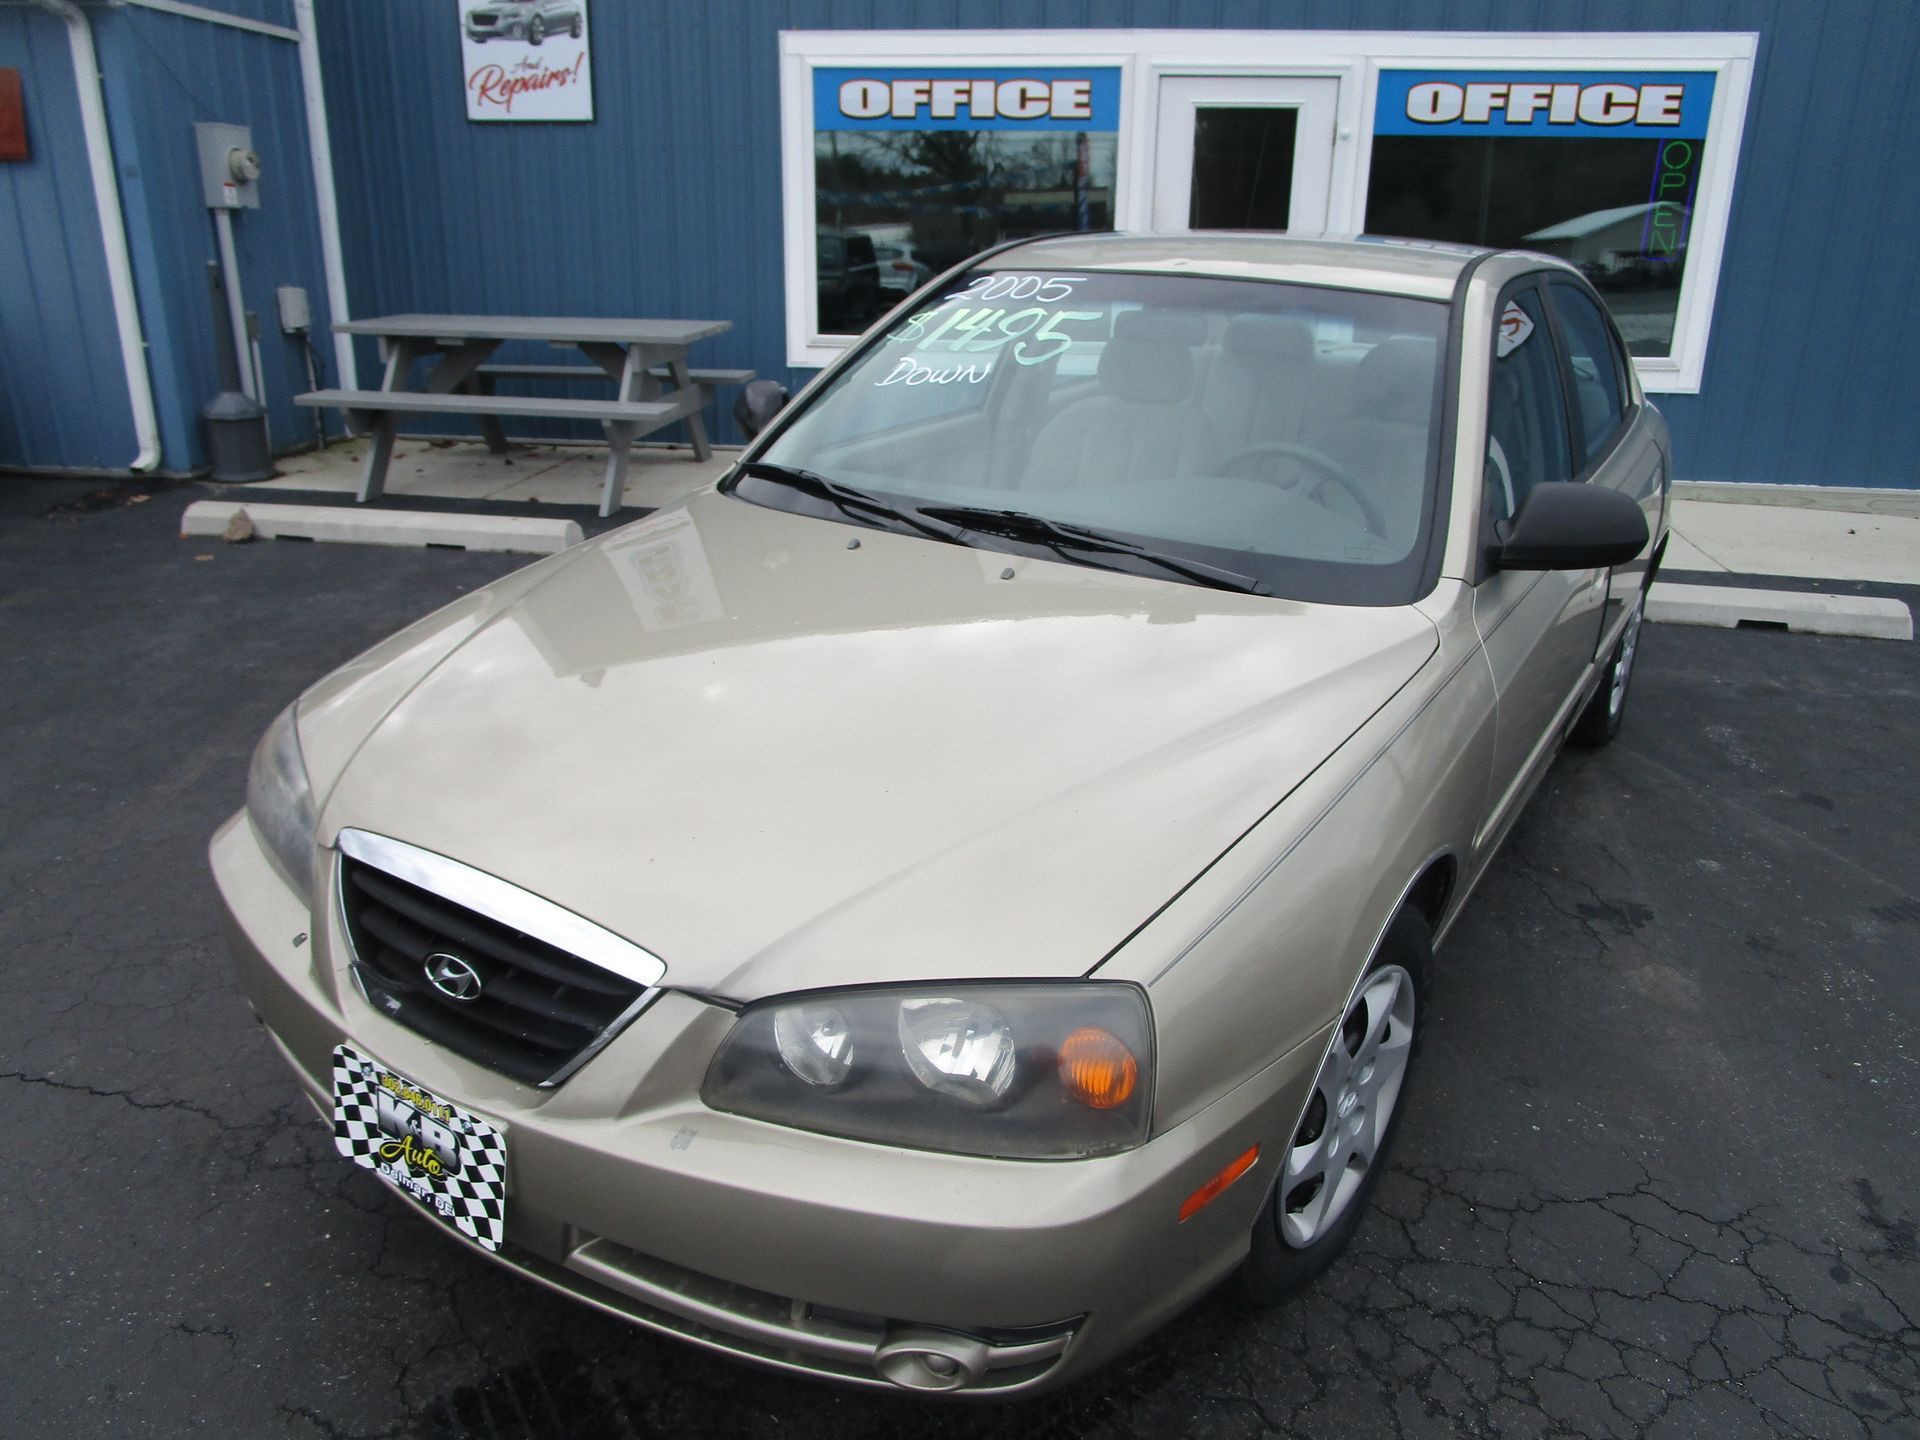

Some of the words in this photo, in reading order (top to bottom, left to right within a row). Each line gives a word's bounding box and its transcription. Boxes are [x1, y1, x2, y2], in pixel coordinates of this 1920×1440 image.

[468, 51, 585, 113] Repairs!
[838, 78, 1092, 120] OFFICE
[1405, 81, 1685, 125] OFFICE
[1649, 140, 1692, 255] OPEN
[944, 276, 1088, 303] 2005
[887, 307, 1103, 365] $1495
[379, 1134, 445, 1177] Auto
[380, 1162, 431, 1203] Delmar,
[434, 1197, 454, 1216] DE
